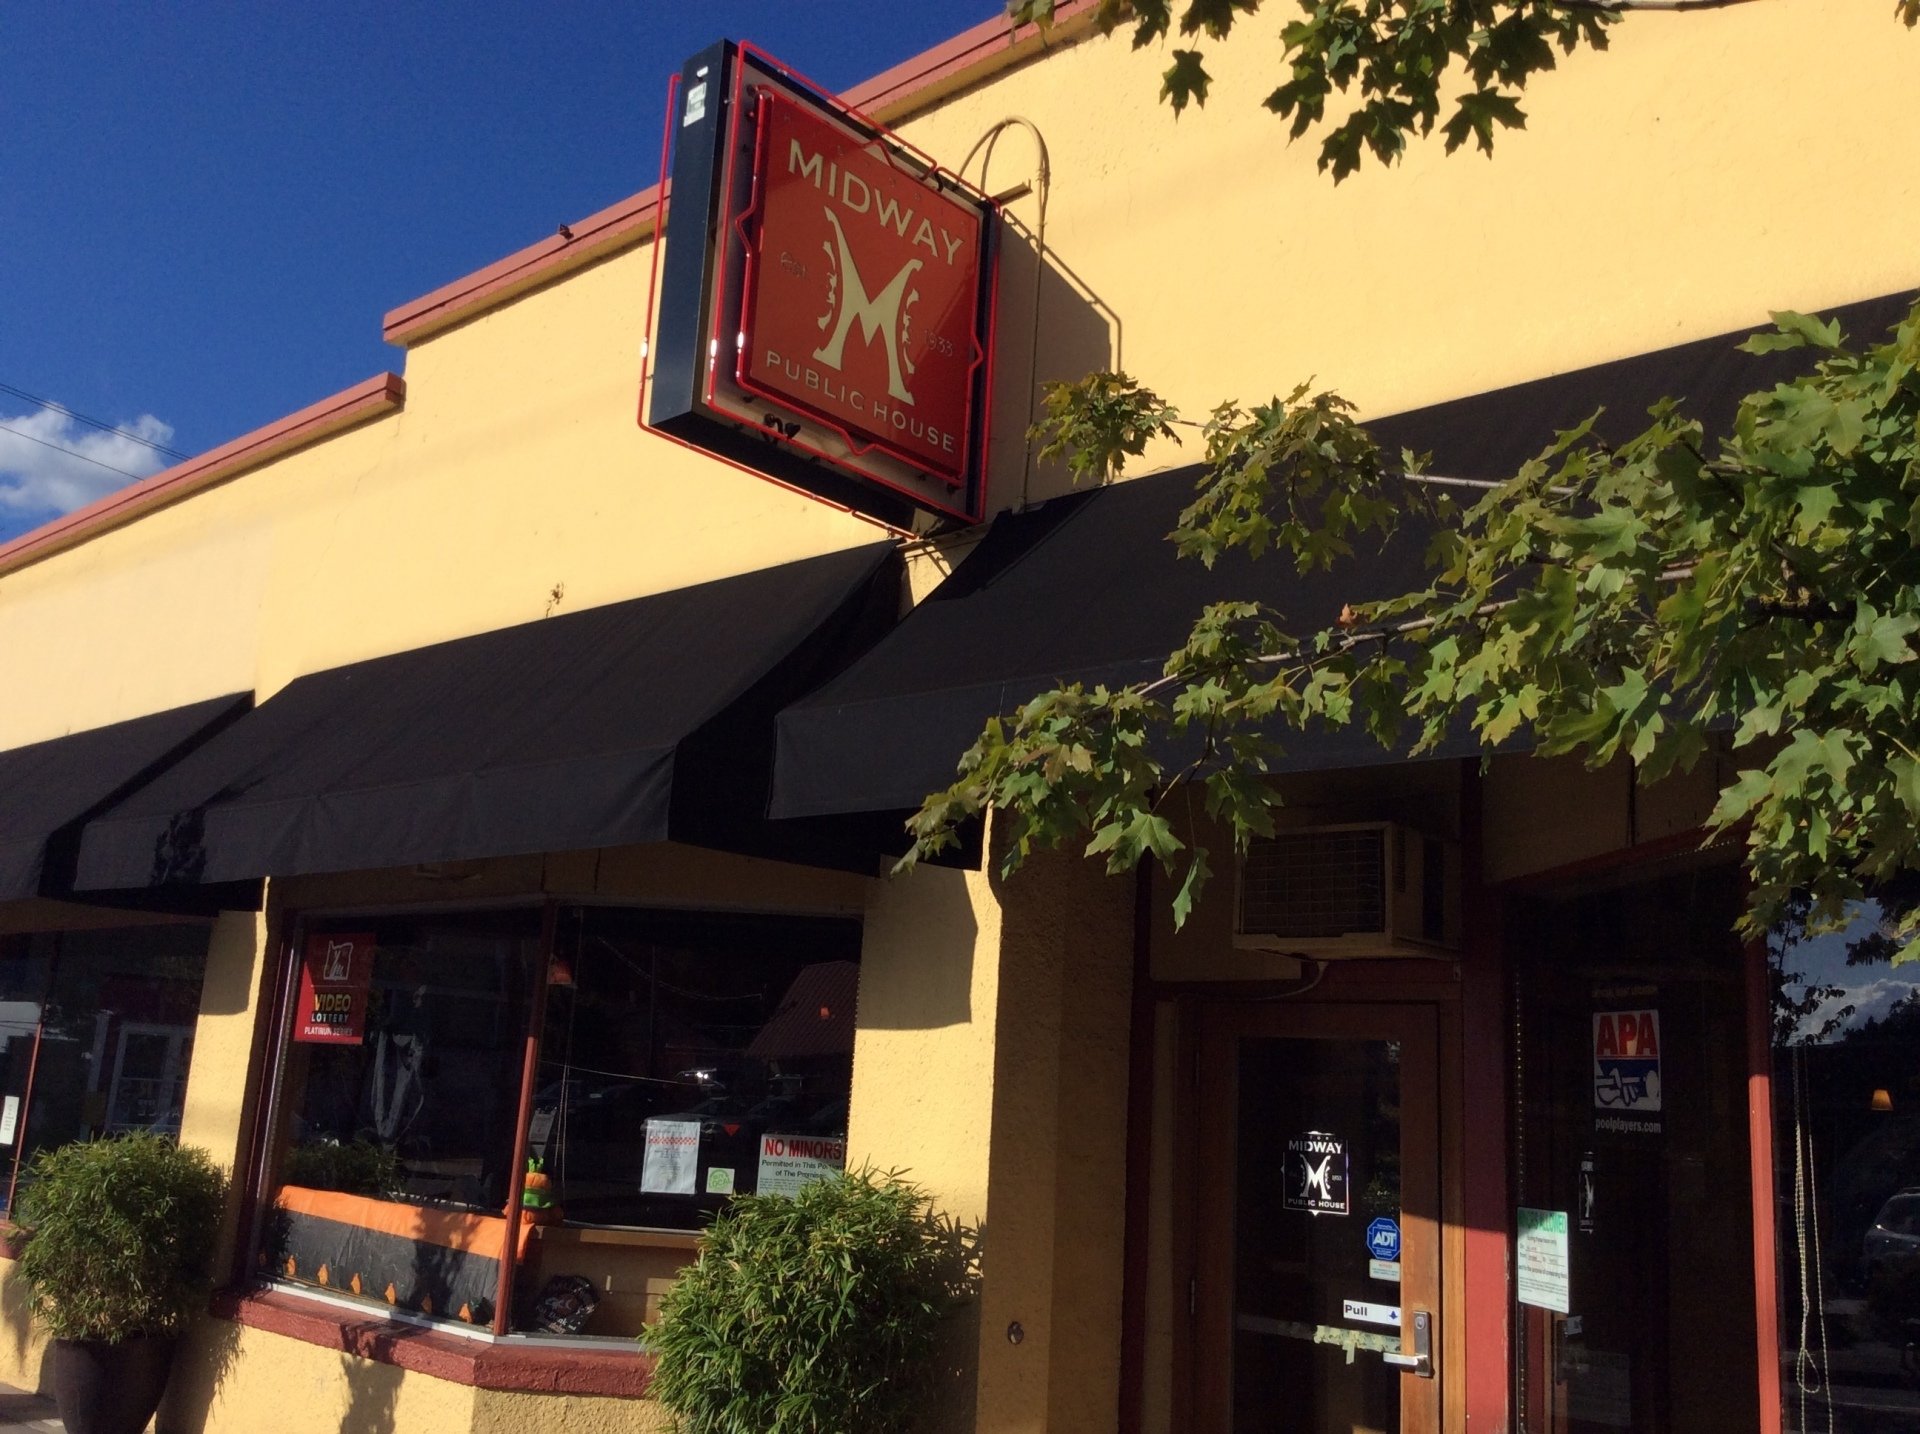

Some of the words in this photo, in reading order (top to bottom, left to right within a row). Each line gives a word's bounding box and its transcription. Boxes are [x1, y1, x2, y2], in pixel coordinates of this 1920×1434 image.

[788, 138, 963, 265] MIDWAY
[766, 350, 865, 411] PUBLIC
[873, 401, 955, 453] HOUSE
[314, 993, 352, 1012] VIDEO
[311, 1013, 349, 1023] LOTTERY
[304, 1026, 332, 1036] PLATINUM
[1596, 1013, 1658, 1055] APA
[1595, 1116, 1661, 1133] poolplayers.com
[764, 1138, 785, 1157] NO
[788, 1139, 843, 1160] MINORS
[1288, 1140, 1343, 1154] MIDWAY
[761, 1159, 793, 1169] Permitted
[794, 1161, 801, 1169] in
[776, 1169, 784, 1177] of
[784, 1170, 797, 1178] The
[1288, 1198, 1316, 1207] PUBLIC
[1318, 1201, 1345, 1209] HOUSE
[1372, 1230, 1397, 1247] ADT
[1345, 1304, 1368, 1316] Pull
